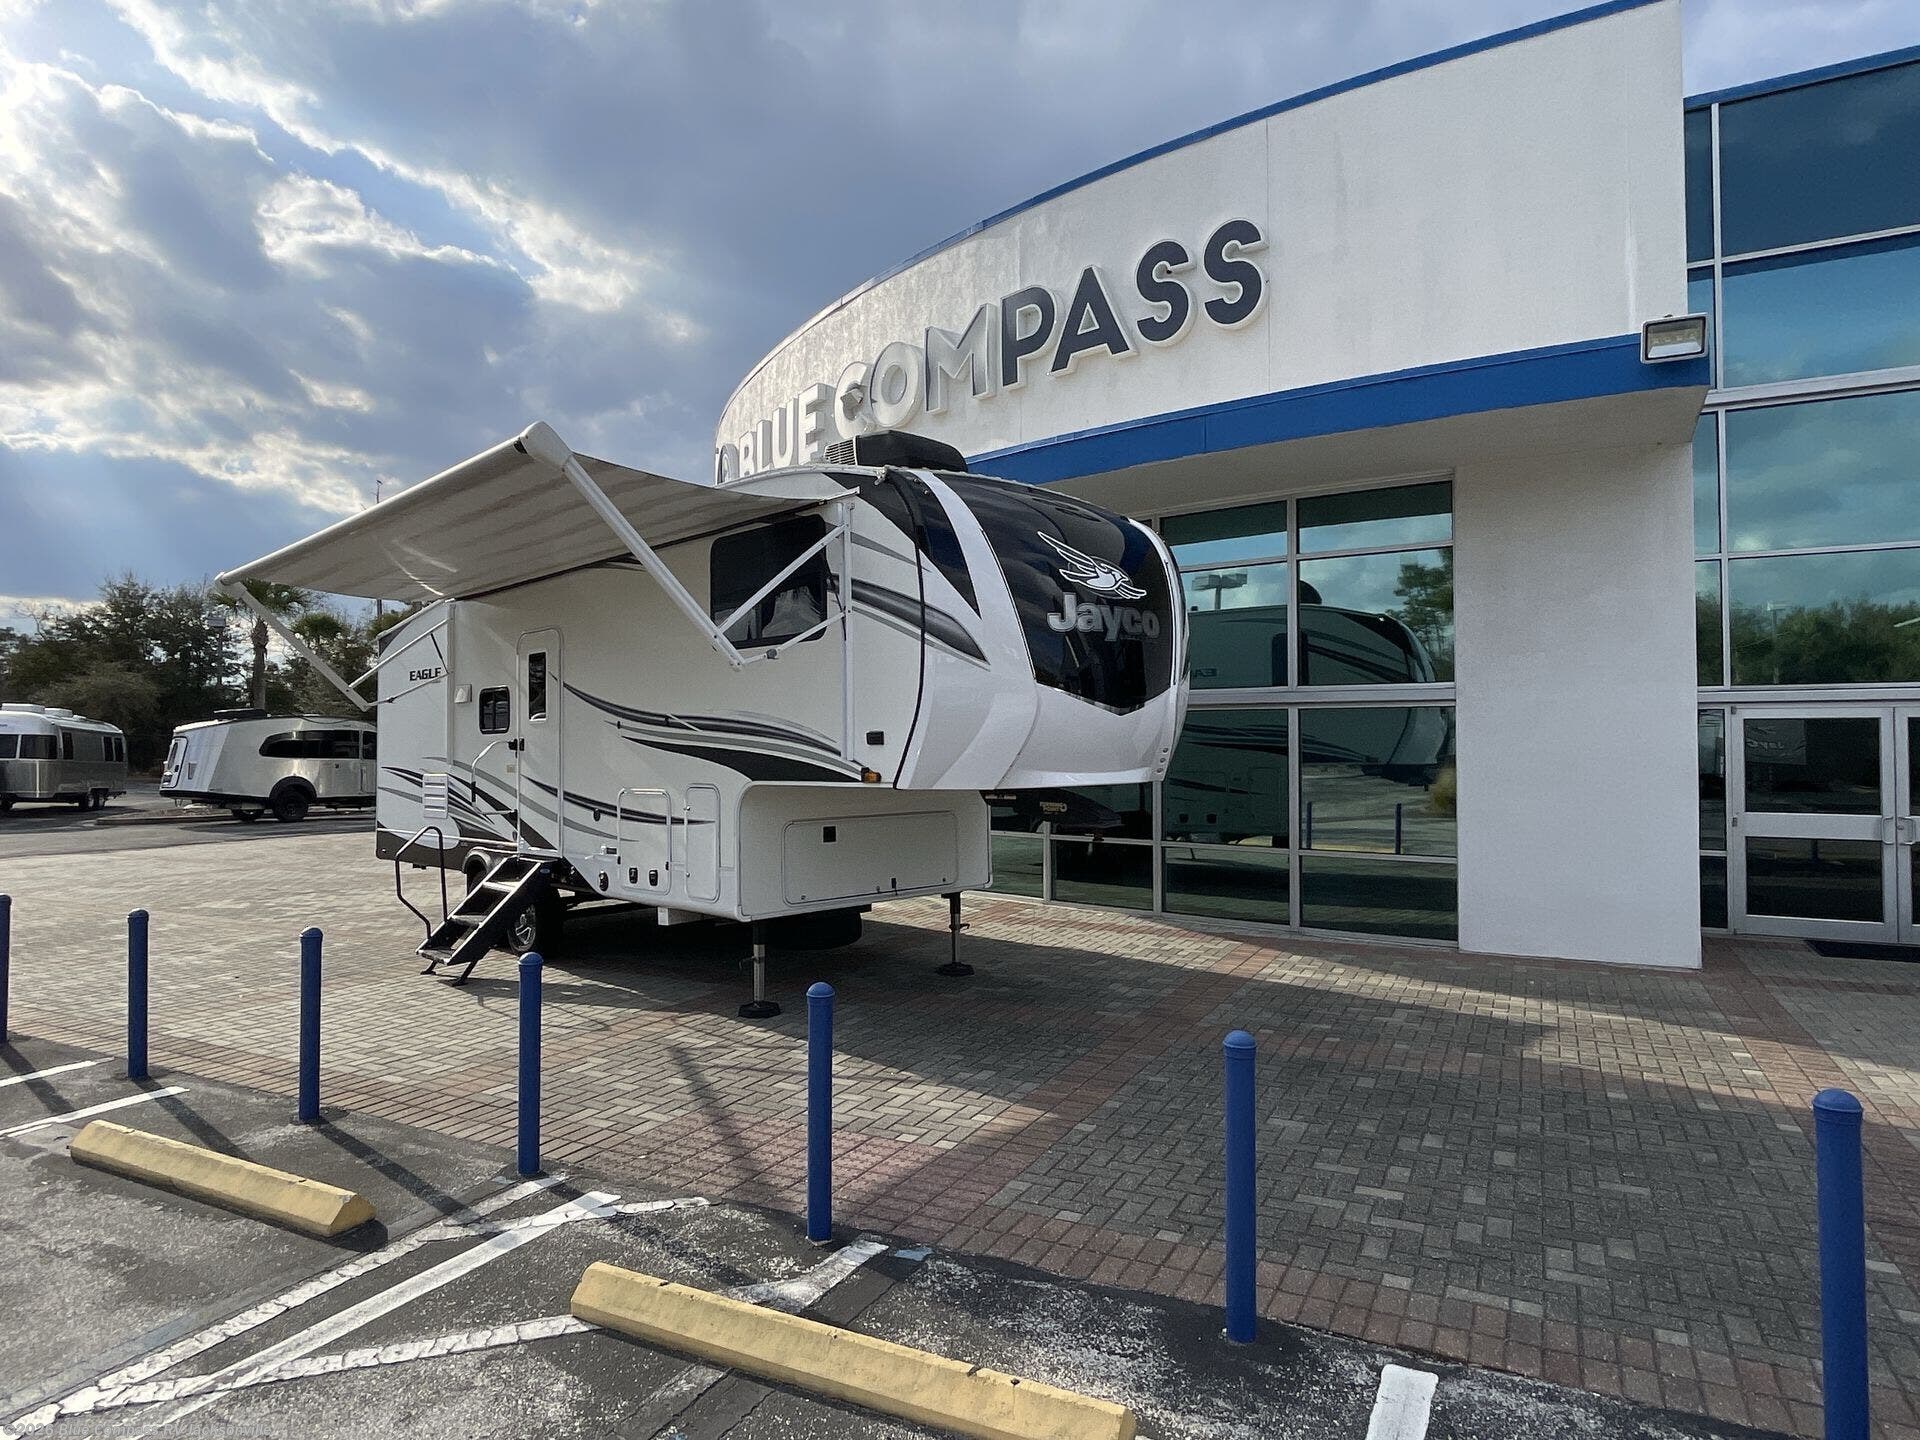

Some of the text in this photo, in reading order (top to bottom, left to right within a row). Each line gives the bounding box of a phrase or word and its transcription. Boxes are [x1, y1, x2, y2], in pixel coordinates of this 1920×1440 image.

[739, 218, 1269, 476] BLUE COMPASS
[1047, 591, 1160, 642] Jayco
[409, 667, 442, 681] EAGLE
